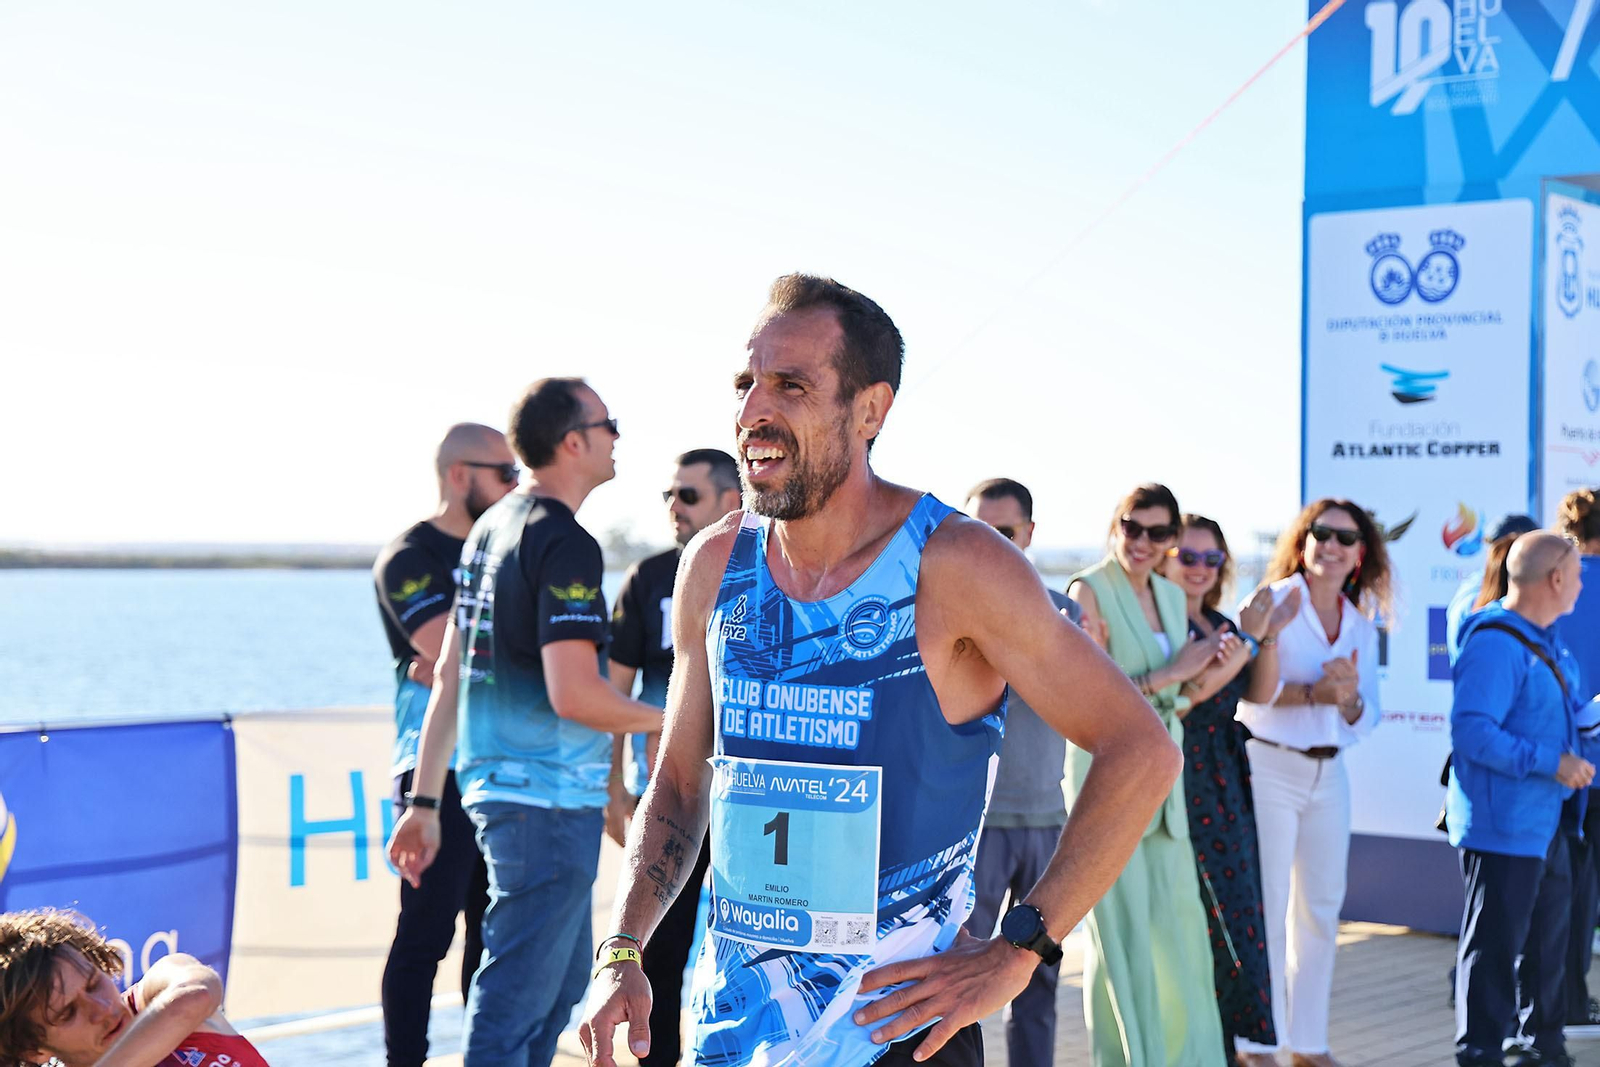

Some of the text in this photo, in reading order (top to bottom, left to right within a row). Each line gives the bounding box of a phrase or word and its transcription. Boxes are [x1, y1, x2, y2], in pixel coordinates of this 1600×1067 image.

[1369, 419, 1461, 438] Fundación
[1426, 440, 1500, 457] COPPER
[722, 624, 746, 640] BY2
[720, 678, 871, 717] CLUB ONUBENSE
[725, 707, 858, 747] DE ATLETISMO
[731, 772, 766, 790] HUELVA
[770, 777, 828, 795] AVATEL
[763, 811, 790, 866] 1
[765, 883, 789, 893] EMILIO
[748, 893, 809, 907] MARTIN ROMERO
[730, 902, 799, 931] Wayalia
